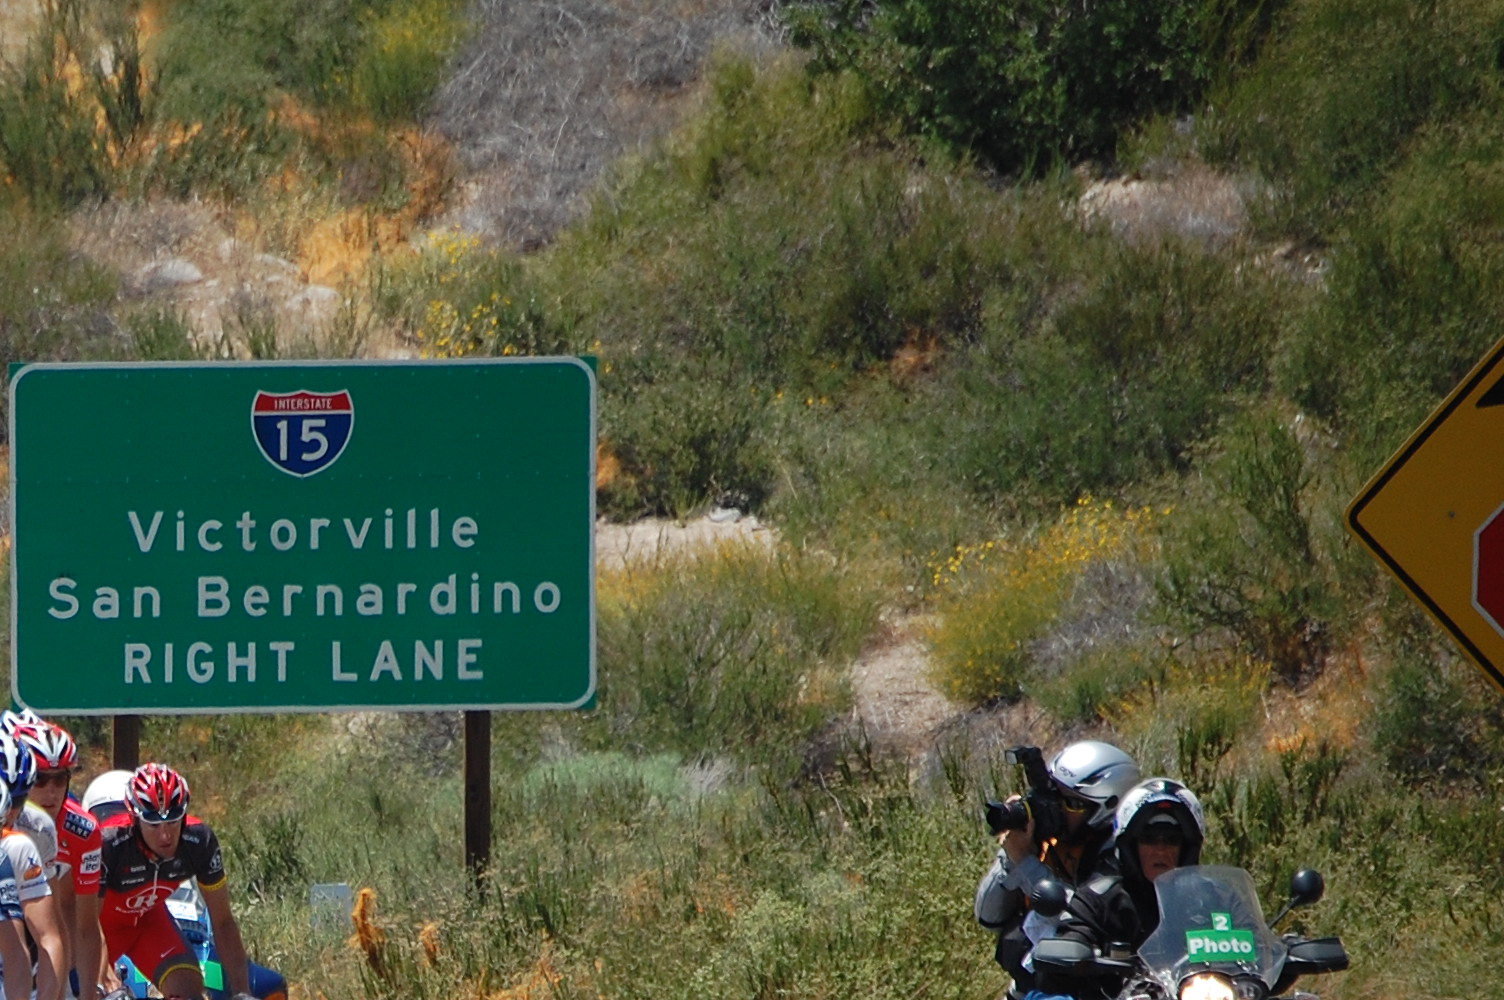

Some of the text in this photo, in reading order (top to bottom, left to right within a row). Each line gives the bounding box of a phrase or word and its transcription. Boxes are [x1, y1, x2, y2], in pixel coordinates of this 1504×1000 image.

[274, 398, 333, 410] INTERSTATE
[276, 419, 329, 462] 15
[127, 507, 479, 552] Victorville
[47, 572, 562, 619] San Bernardino
[124, 638, 484, 684] RIGHT LANE
[1189, 935, 1252, 954] Photo
[1215, 915, 1229, 931] 2
